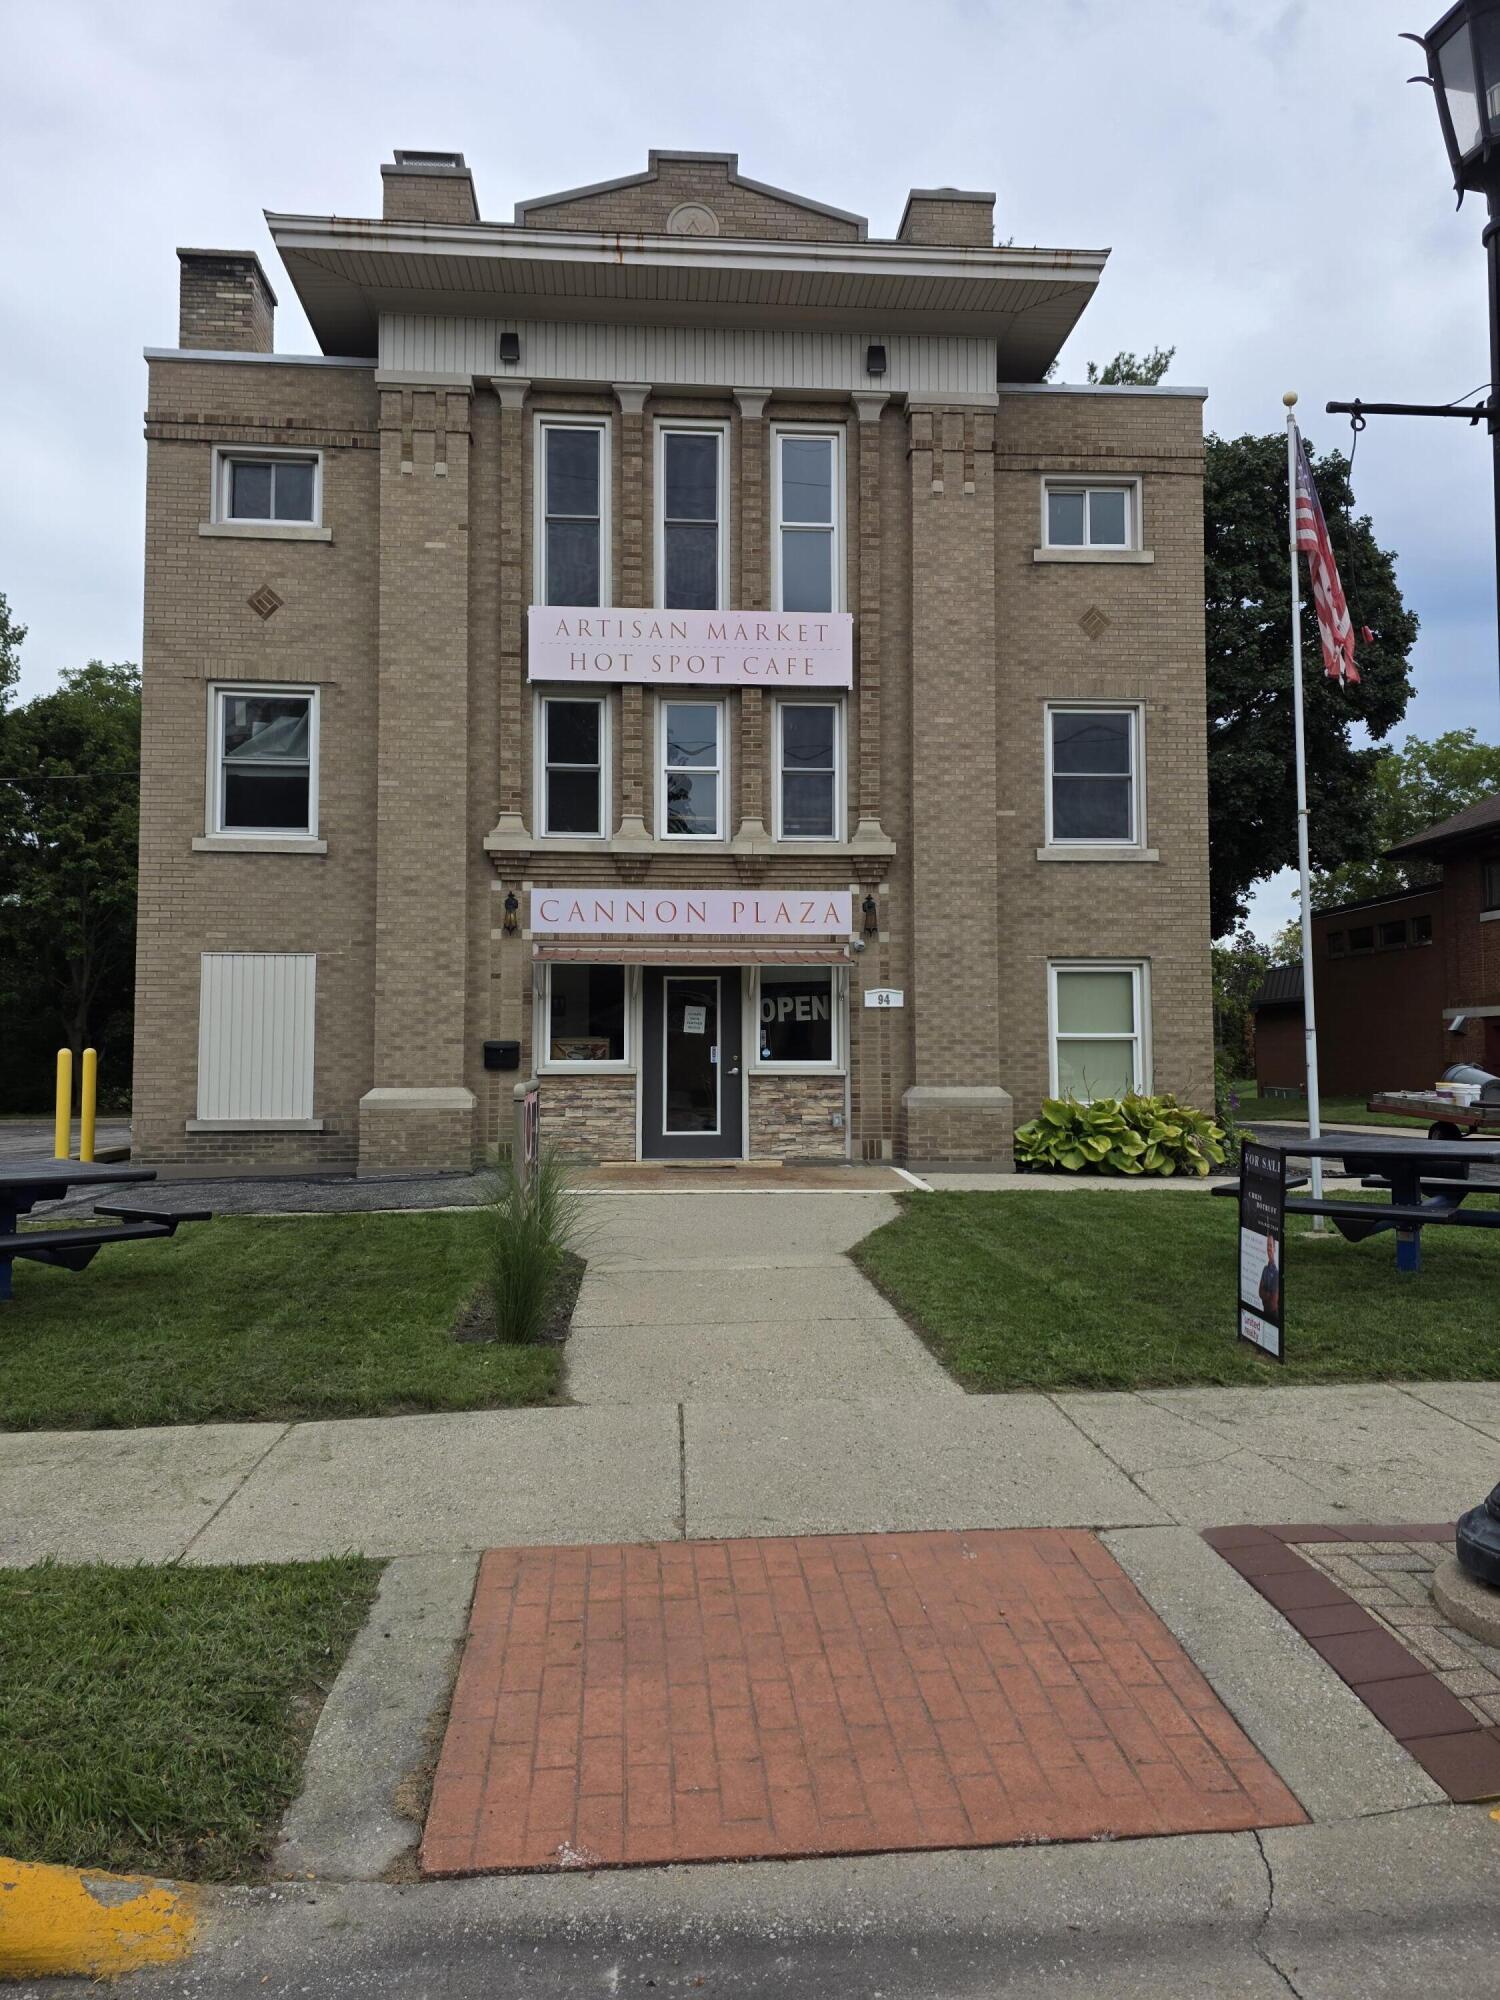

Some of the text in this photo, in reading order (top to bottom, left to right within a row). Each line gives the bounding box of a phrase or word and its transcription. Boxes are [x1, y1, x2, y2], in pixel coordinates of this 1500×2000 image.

[556, 618, 830, 643] ARTISAN MARKET
[569, 652, 815, 676] HOT SPOT CAFE
[539, 899, 842, 924] CANNON PLAZA
[760, 995, 830, 1023] OPEN
[877, 994, 891, 1006] 94
[1245, 1152, 1260, 1168] FOR
